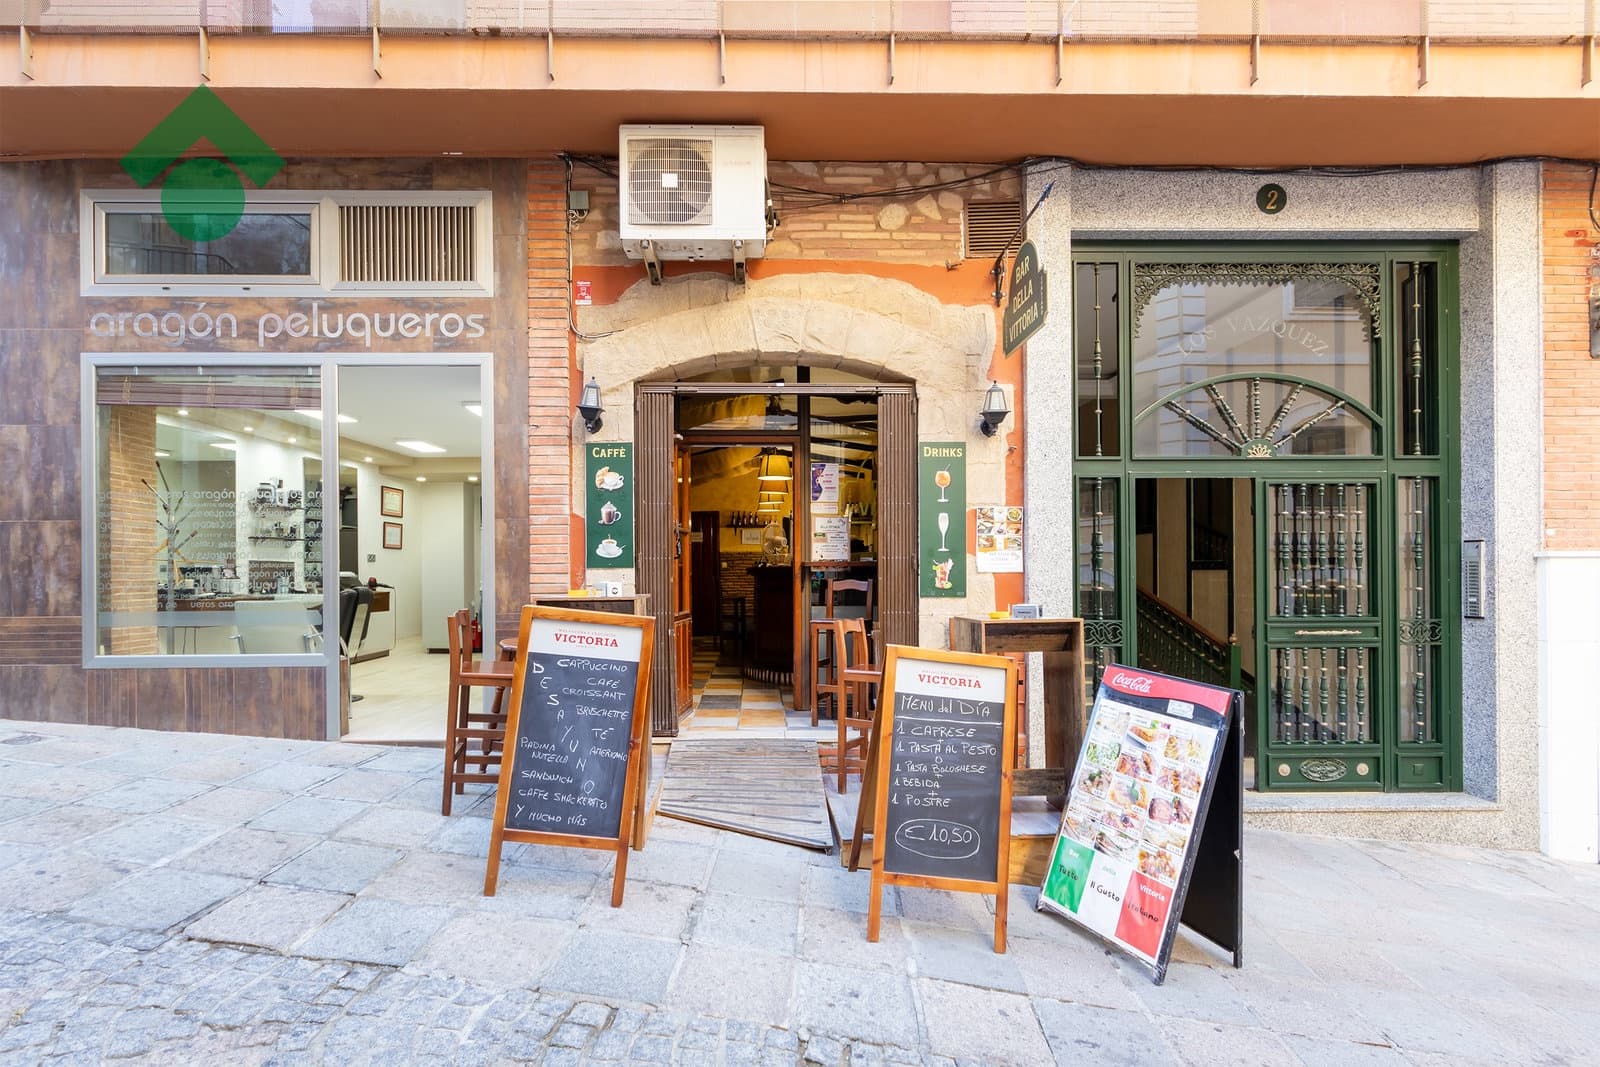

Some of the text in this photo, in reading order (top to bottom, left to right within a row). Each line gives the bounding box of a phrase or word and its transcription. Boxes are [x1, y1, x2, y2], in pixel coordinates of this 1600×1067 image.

[1266, 190, 1279, 210] 2
[1015, 255, 1031, 285] BAR
[1012, 279, 1034, 313] DELLA
[89, 303, 487, 347] aragón peluqueros
[1008, 301, 1040, 343] VITTORIA
[922, 445, 964, 458] DRINKS
[554, 631, 619, 648] VICTORIA
[557, 658, 628, 672] CAPPUCCINO
[918, 673, 982, 689] VICTORIA
[562, 687, 627, 701] CROISSANT
[901, 695, 934, 712] MENU
[896, 720, 977, 738] 1 CAPRESE
[895, 741, 997, 756] 1 PASTA AL PESTO
[531, 751, 569, 764] NUTELLA
[895, 760, 988, 774] 1 PASTA BOLOGNESE
[521, 769, 574, 784] SANDWICH
[894, 777, 941, 788] 1 BEBIDA
[891, 792, 952, 807] 1 POSTRE
[514, 803, 525, 818] Y
[528, 811, 562, 823] MUCHO
[1058, 863, 1080, 882] Tutto
[1096, 884, 1121, 903] Gusto
